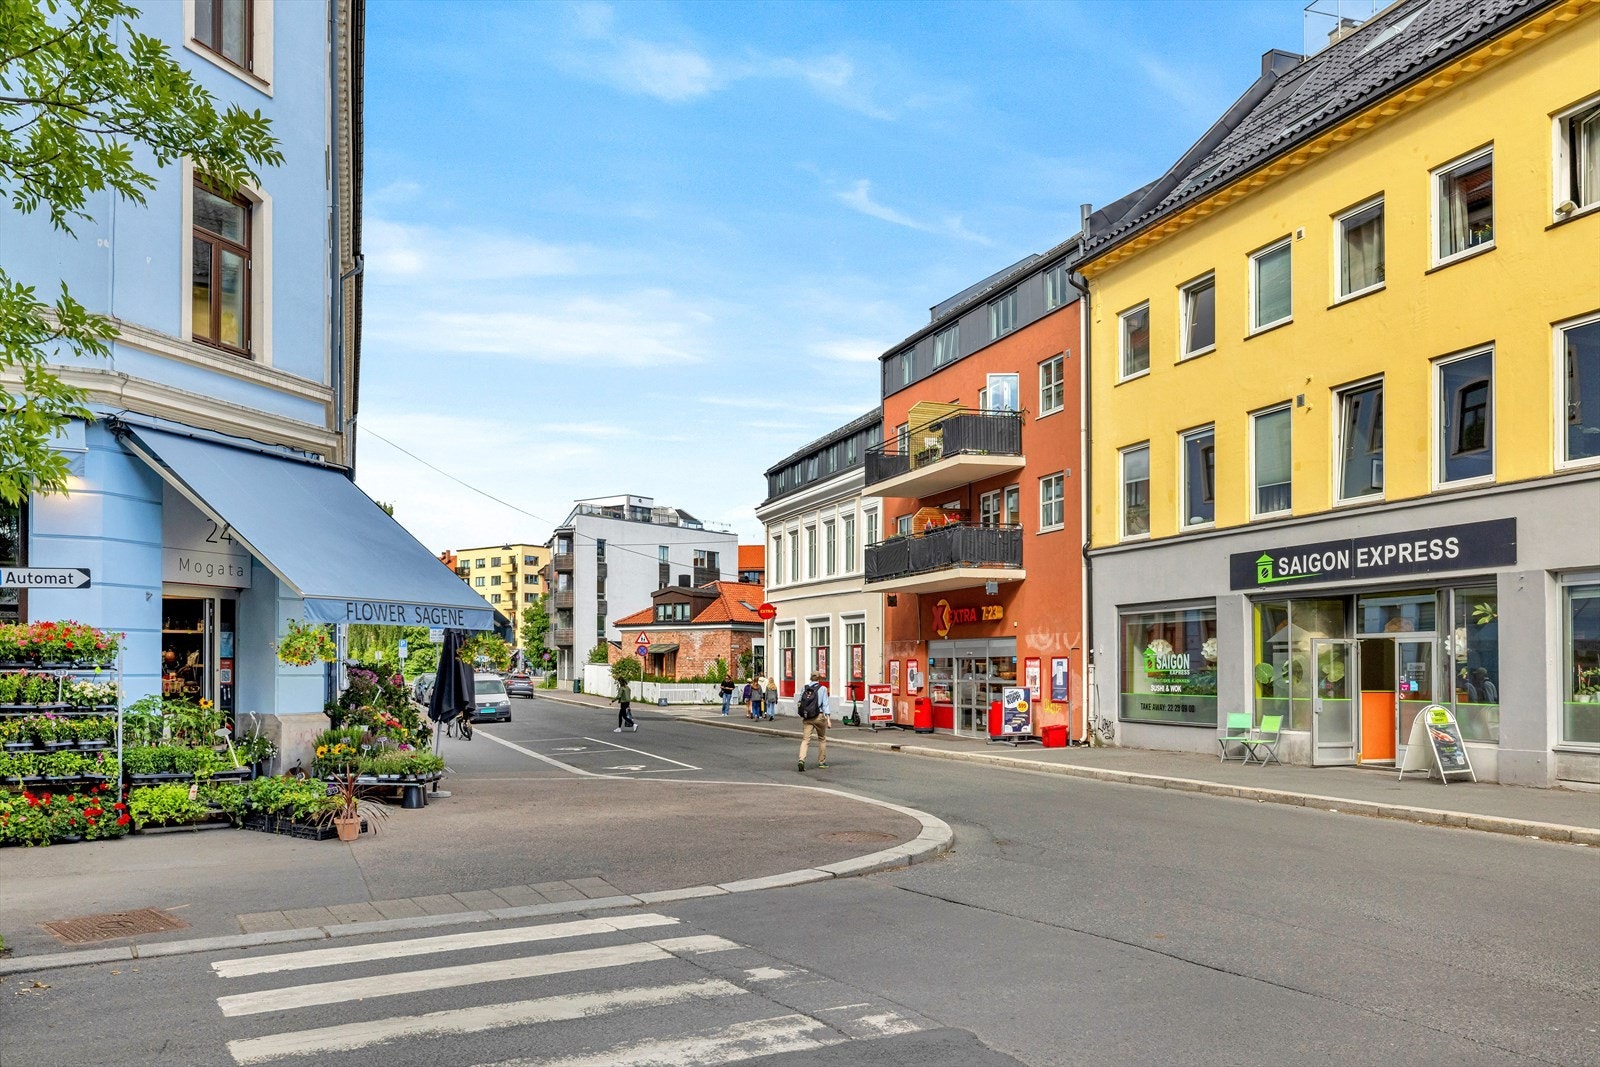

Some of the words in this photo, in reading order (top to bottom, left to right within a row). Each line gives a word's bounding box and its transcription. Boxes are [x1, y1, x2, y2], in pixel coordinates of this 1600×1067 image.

[206, 518, 239, 545] 24
[1278, 550, 1350, 576] SAIGON
[1357, 536, 1459, 568] EXPRESS
[179, 557, 244, 578] Mogata
[5, 571, 74, 585] Automat
[346, 602, 406, 623] FLOWER
[415, 606, 465, 626] SAGENE
[948, 607, 977, 623] EXTRA
[1156, 654, 1190, 669] SAIGON
[1140, 703, 1151, 711] TAKE
[1152, 703, 1166, 712] AWAY:
